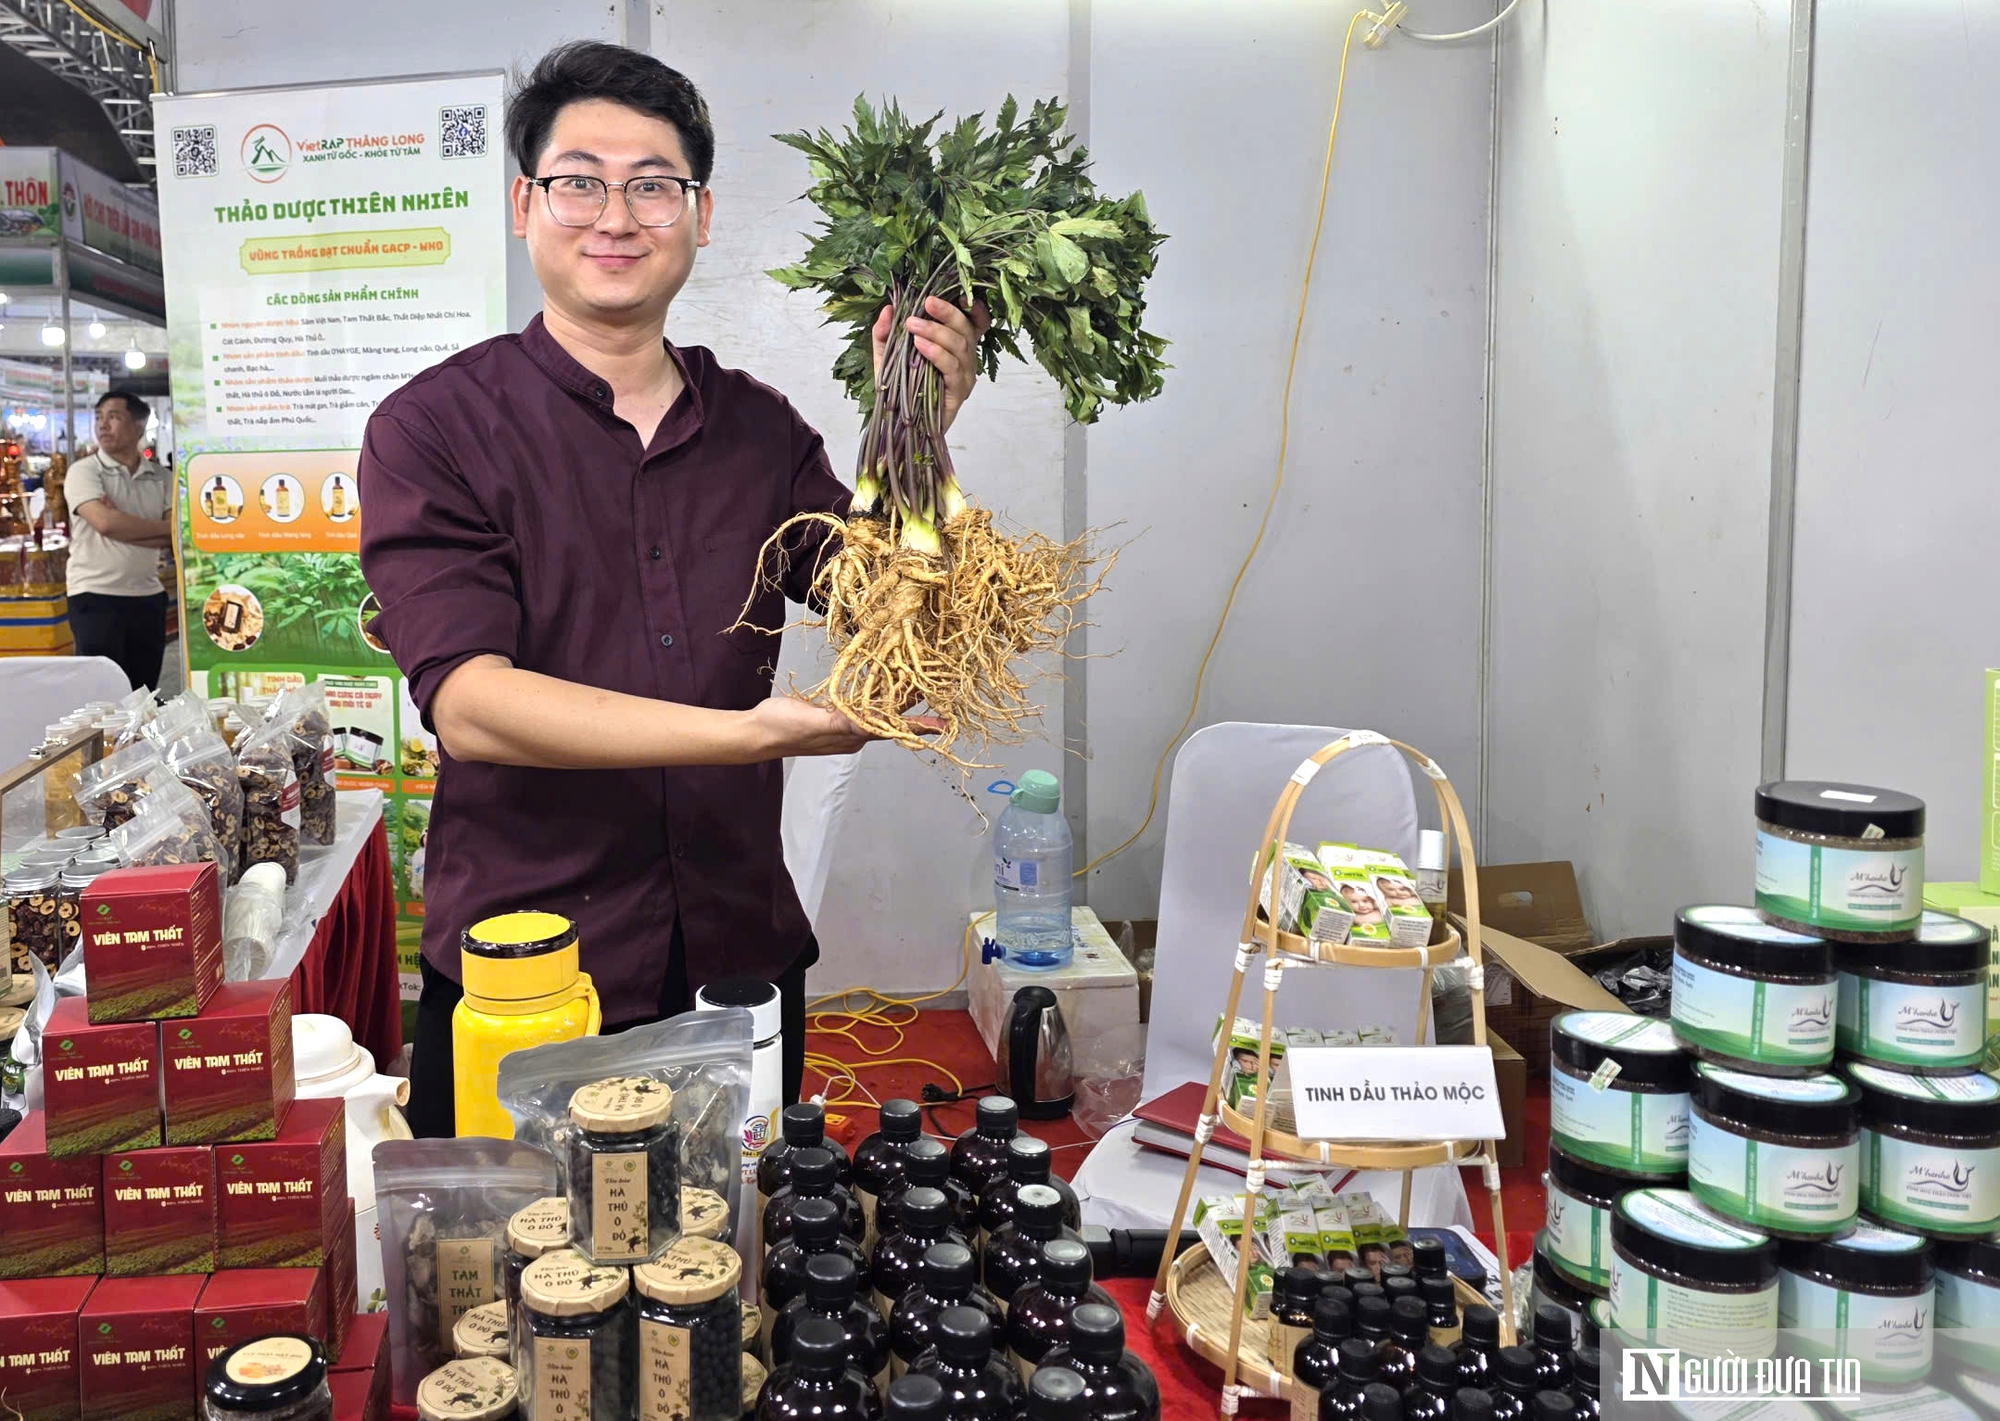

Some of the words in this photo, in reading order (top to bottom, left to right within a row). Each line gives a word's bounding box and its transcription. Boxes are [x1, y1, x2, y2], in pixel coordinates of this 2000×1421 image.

[296, 137, 344, 152] VietRAP
[345, 134, 389, 148] THĂNG
[392, 133, 425, 146] LONG
[302, 152, 326, 163] XANH
[326, 150, 338, 161] TỪ
[338, 149, 357, 160] GỐC
[389, 147, 402, 158] TỪ
[402, 147, 420, 156] TÂM
[5, 176, 48, 206] THÔN
[214, 198, 268, 224] THẢO
[273, 199, 326, 223] DƯỢC
[330, 190, 396, 215] THIÊN
[401, 186, 469, 211] NHIÊN
[249, 248, 279, 261] VÙNG
[281, 244, 318, 259] TRỒNG
[340, 239, 379, 257] CHUẨN
[381, 243, 411, 254] GACP
[419, 240, 444, 251] WHO
[266, 293, 289, 305] CÁC
[290, 293, 321, 305] DÒNG
[322, 289, 341, 303] SẢN
[344, 284, 378, 301] PHẨM
[380, 286, 419, 300] CHÍNH
[359, 314, 375, 322] Thất
[410, 313, 425, 321] Diệp
[426, 312, 443, 320] Nhất
[362, 346, 383, 354] Màng
[401, 346, 419, 354] Long
[361, 373, 381, 382] ngâm
[92, 931, 120, 946] VIÊN
[123, 930, 150, 943] TAM
[152, 924, 183, 941] THẤT
[174, 1055, 201, 1070] VIÊN
[204, 1055, 230, 1068] TAM
[233, 1048, 263, 1066] THẤT
[54, 1066, 84, 1082] VIÊN
[87, 1064, 114, 1078] TAM
[117, 1056, 149, 1074] THẤT
[1305, 1087, 1345, 1102] TINH
[1350, 1078, 1385, 1101] DẦU
[1390, 1081, 1438, 1101] THẢO
[1443, 1081, 1485, 1105] MỘC
[4, 1188, 32, 1203] VIÊN
[35, 1189, 61, 1201] TAM
[64, 1183, 94, 1200] THẤT
[115, 1187, 142, 1201] VIÊN
[144, 1186, 170, 1200] TAM
[174, 1182, 203, 1198] THẤT
[226, 1180, 253, 1195] VIÊN
[256, 1180, 281, 1194] TAM
[284, 1177, 313, 1193] THẤT
[607, 1201, 628, 1212] THỦ
[614, 1216, 621, 1227] Ô
[612, 1229, 626, 1241] ĐỎ
[452, 1270, 478, 1281] TAM
[449, 1284, 482, 1298] THẤT
[8, 1353, 35, 1367] TAM
[39, 1347, 70, 1364] THẤT
[93, 1351, 121, 1366] VIÊN
[124, 1351, 150, 1364] TAM
[154, 1344, 186, 1362] THẤT
[548, 1387, 571, 1400] THỦ
[555, 1403, 564, 1414] Ô
